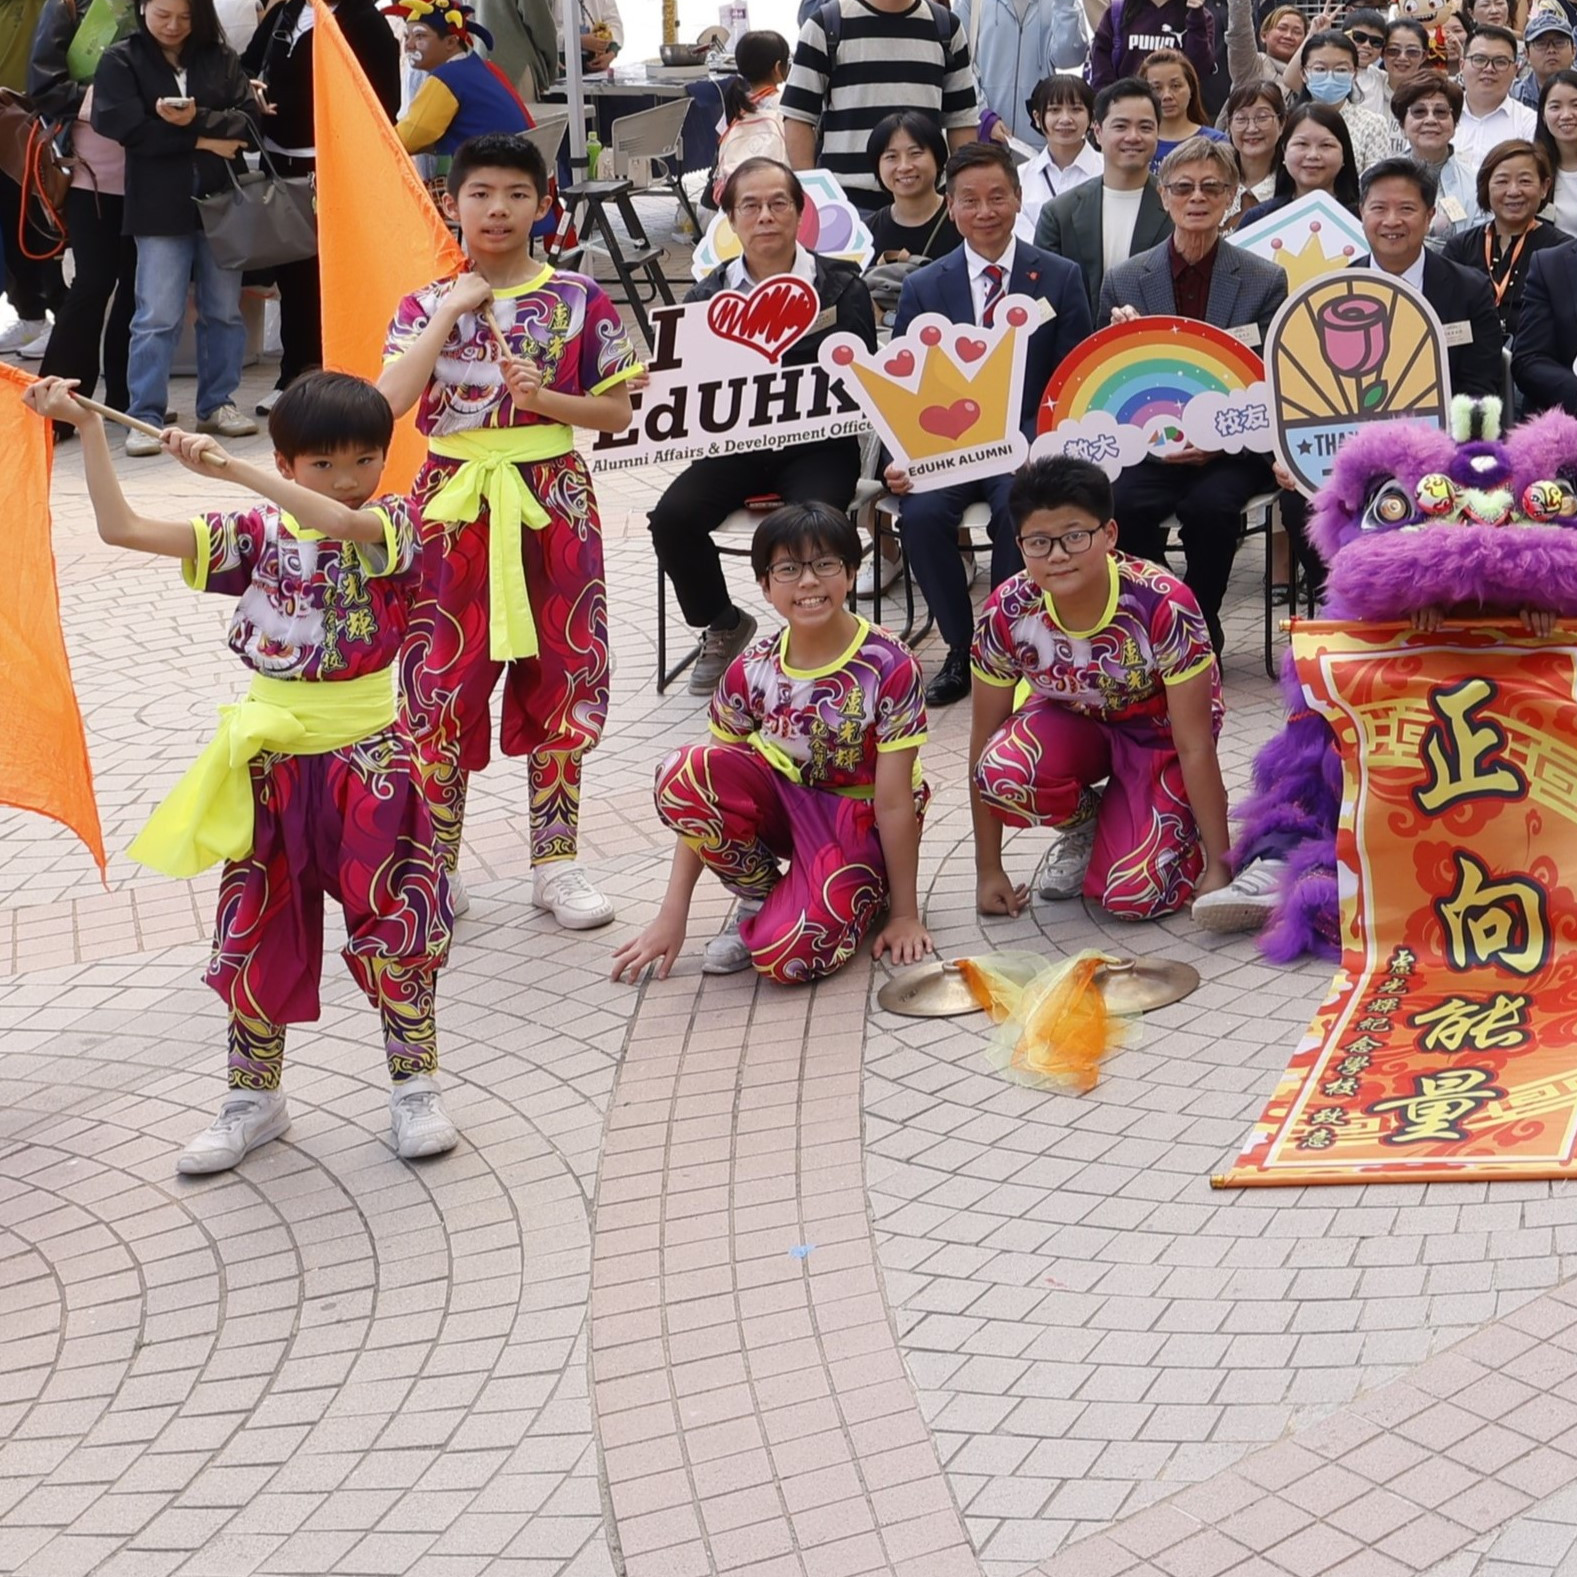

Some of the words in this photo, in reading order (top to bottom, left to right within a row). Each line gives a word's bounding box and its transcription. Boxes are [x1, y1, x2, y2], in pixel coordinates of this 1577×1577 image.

[647, 308, 686, 373] I
[1214, 402, 1270, 437] 校友
[592, 452, 649, 473] Alumni
[653, 444, 705, 464] Affairs
[708, 442, 720, 455] &
[724, 425, 827, 454] Development
[908, 457, 957, 478] EdUHK
[959, 444, 1014, 469] ALUMNI
[1374, 679, 1546, 1143] 正向能量
[1301, 1106, 1348, 1149] 致意
